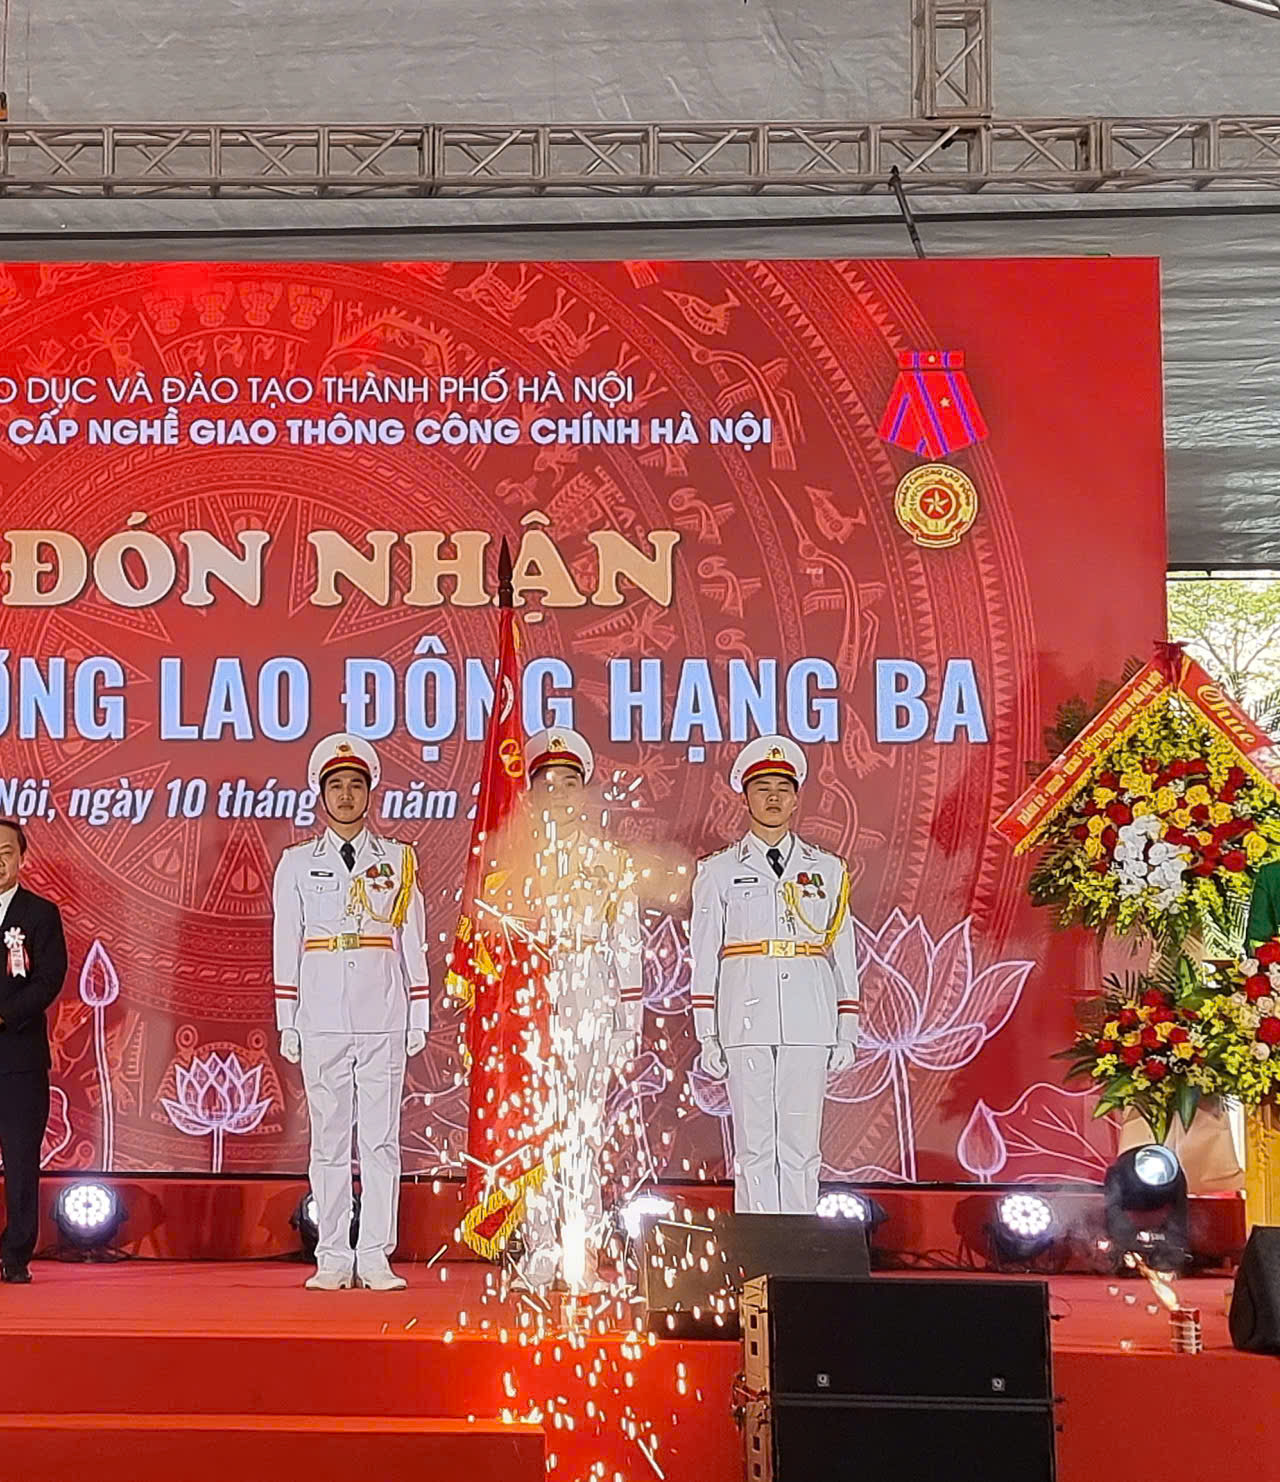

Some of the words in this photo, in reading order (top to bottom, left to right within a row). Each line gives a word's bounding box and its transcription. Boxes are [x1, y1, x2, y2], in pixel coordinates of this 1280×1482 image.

[27, 377, 97, 409] DỤC
[106, 372, 153, 403] VÀ
[162, 372, 238, 403] ĐÀO
[247, 377, 312, 409] TẠO
[322, 372, 429, 403] THÀNH
[440, 368, 509, 403] PHỐ
[518, 372, 563, 403] HÀ
[574, 370, 633, 409] NỘI
[8, 405, 78, 445] CẤP
[89, 407, 179, 445] NGHỀ
[189, 419, 276, 445] GIAO
[286, 412, 406, 445] THÔNG
[415, 412, 520, 445] CÔNG
[530, 411, 639, 444] CHÍNH
[651, 412, 699, 444] HÀ
[710, 412, 772, 451] NỘI
[1, 511, 270, 608] ĐÓN
[309, 510, 681, 623] NHẬN
[160, 656, 311, 740] LAO
[609, 657, 838, 763] HẠNG
[875, 658, 989, 743] BA
[69, 778, 154, 826] ngày
[166, 778, 207, 818] 10
[217, 778, 317, 826] tháng
[381, 781, 458, 819] năm
